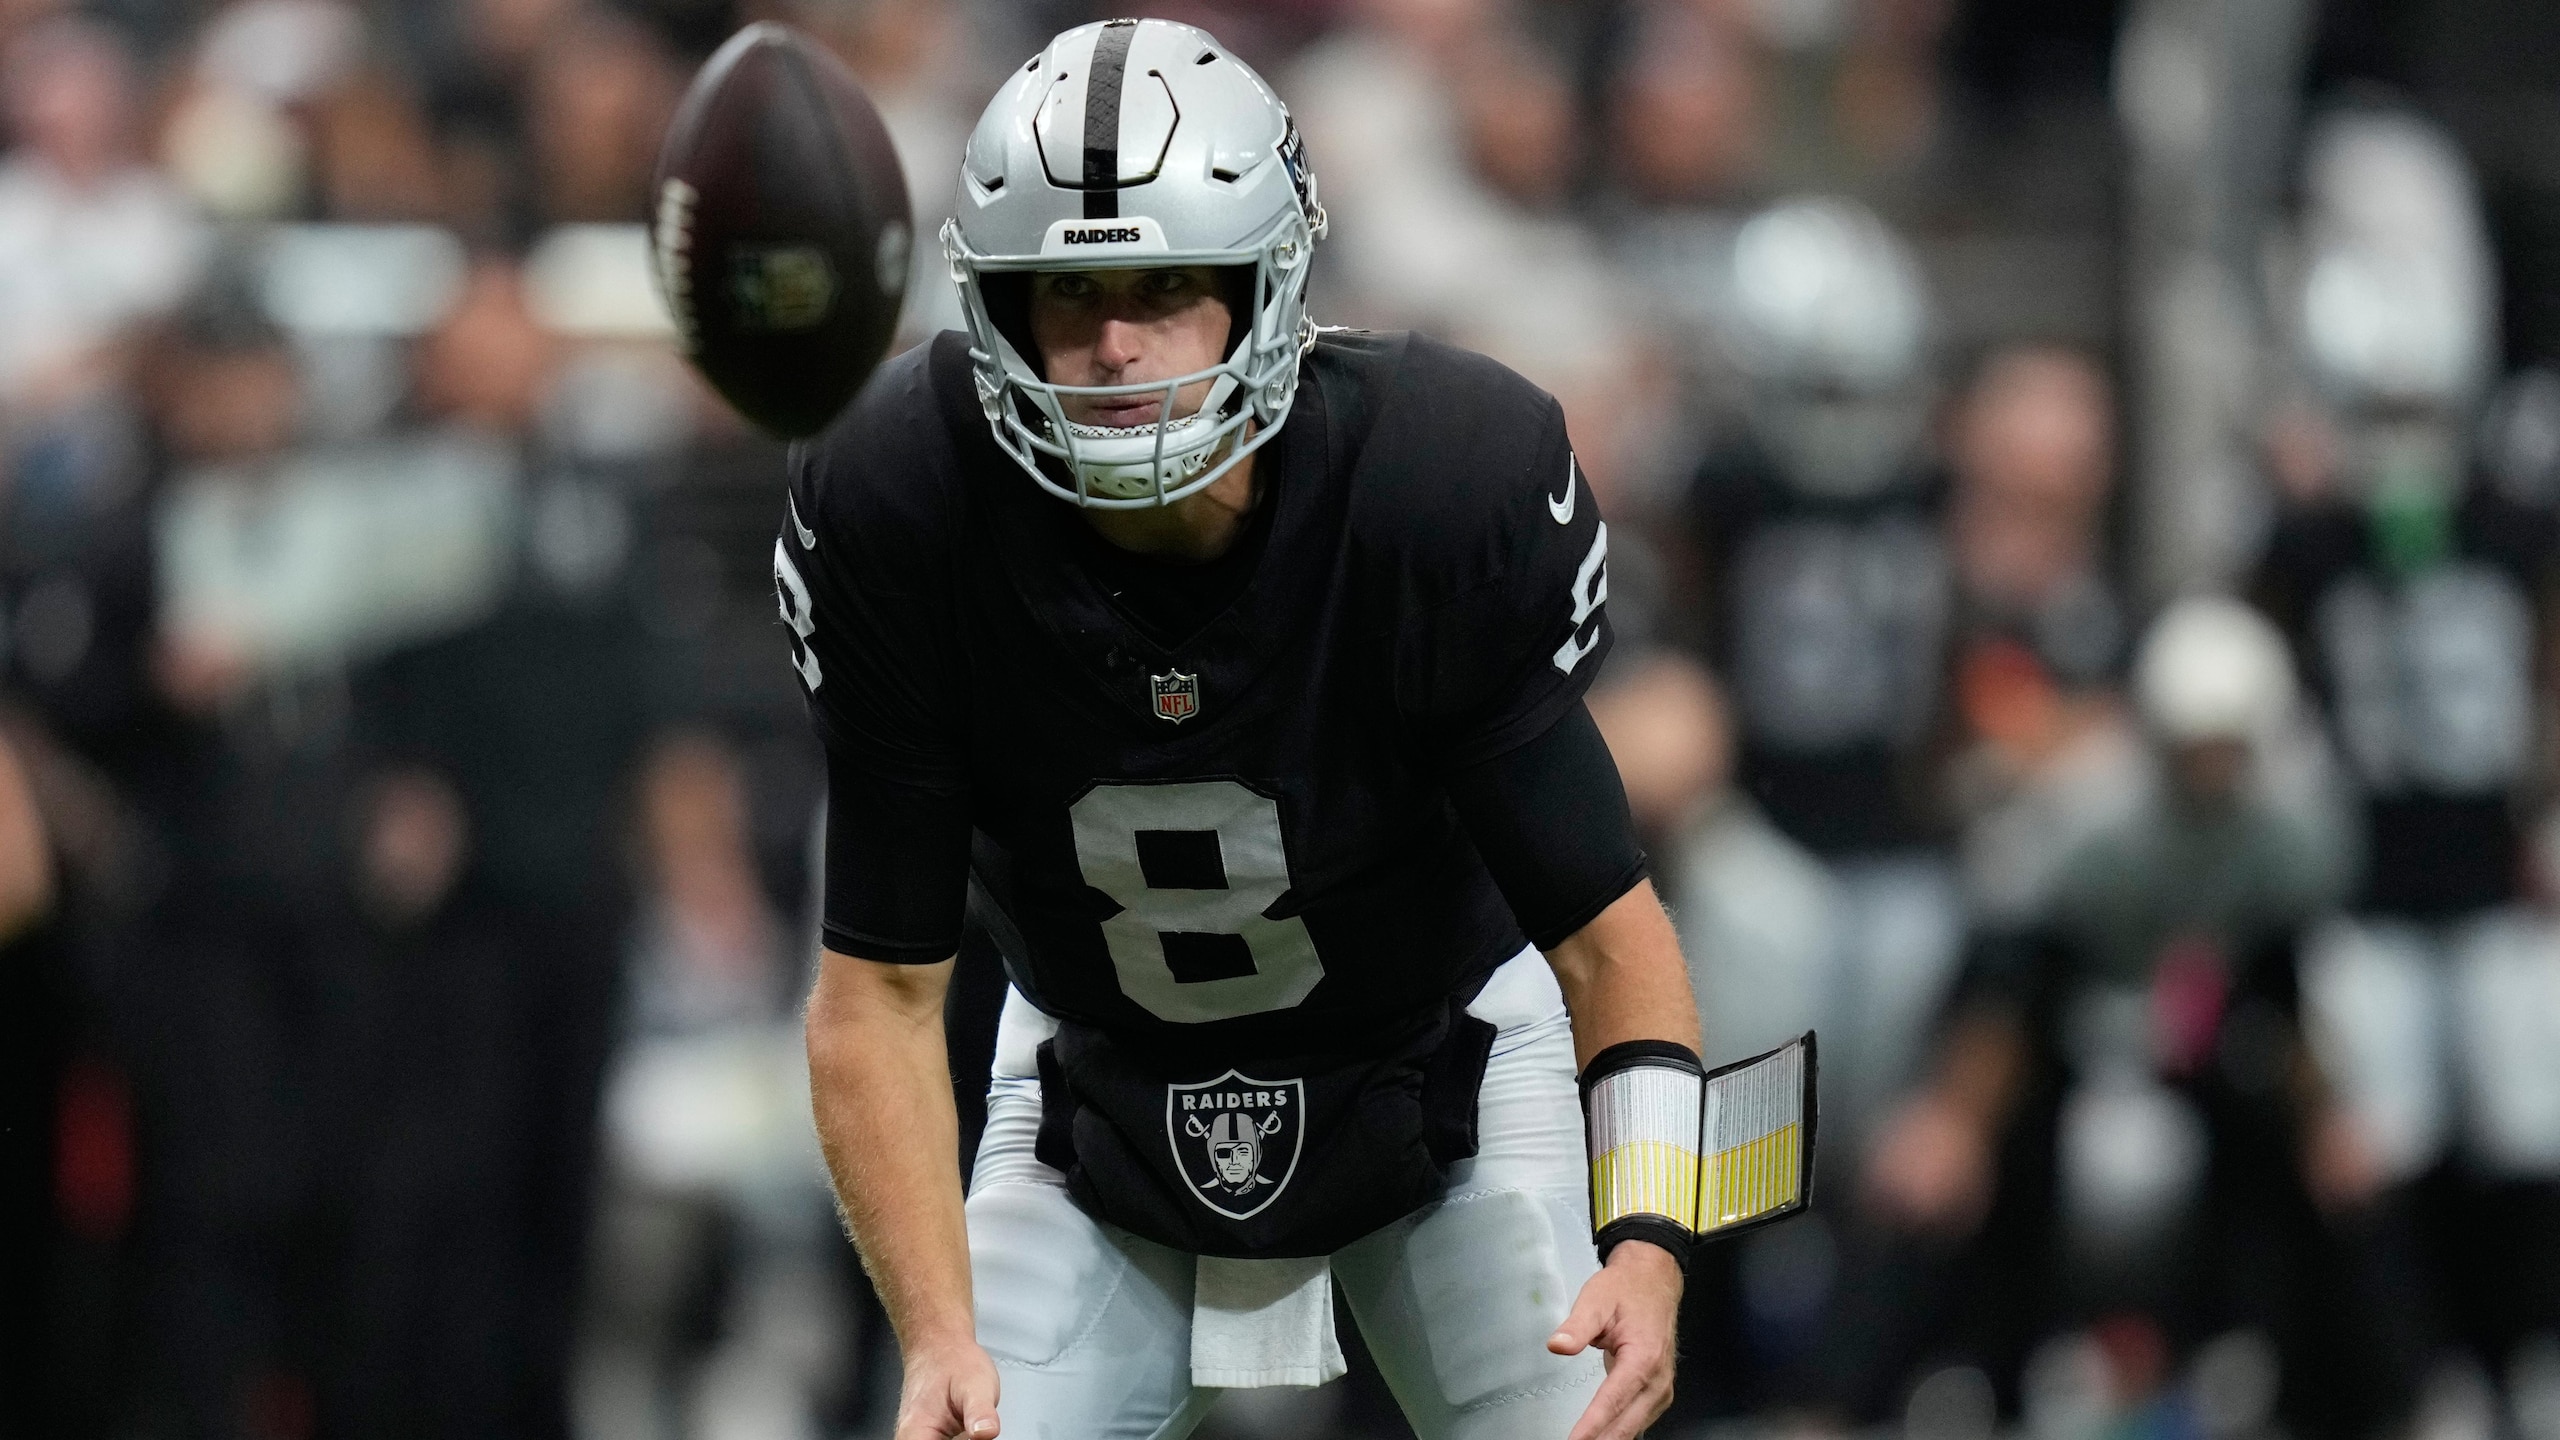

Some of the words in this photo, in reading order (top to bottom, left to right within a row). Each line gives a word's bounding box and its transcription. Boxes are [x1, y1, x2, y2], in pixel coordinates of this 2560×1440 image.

[1064, 228, 1141, 245] RAIDERS
[1160, 694, 1193, 715] NFL
[1069, 781, 1325, 1024] 8
[1182, 1089, 1288, 1111] RAIDERS
